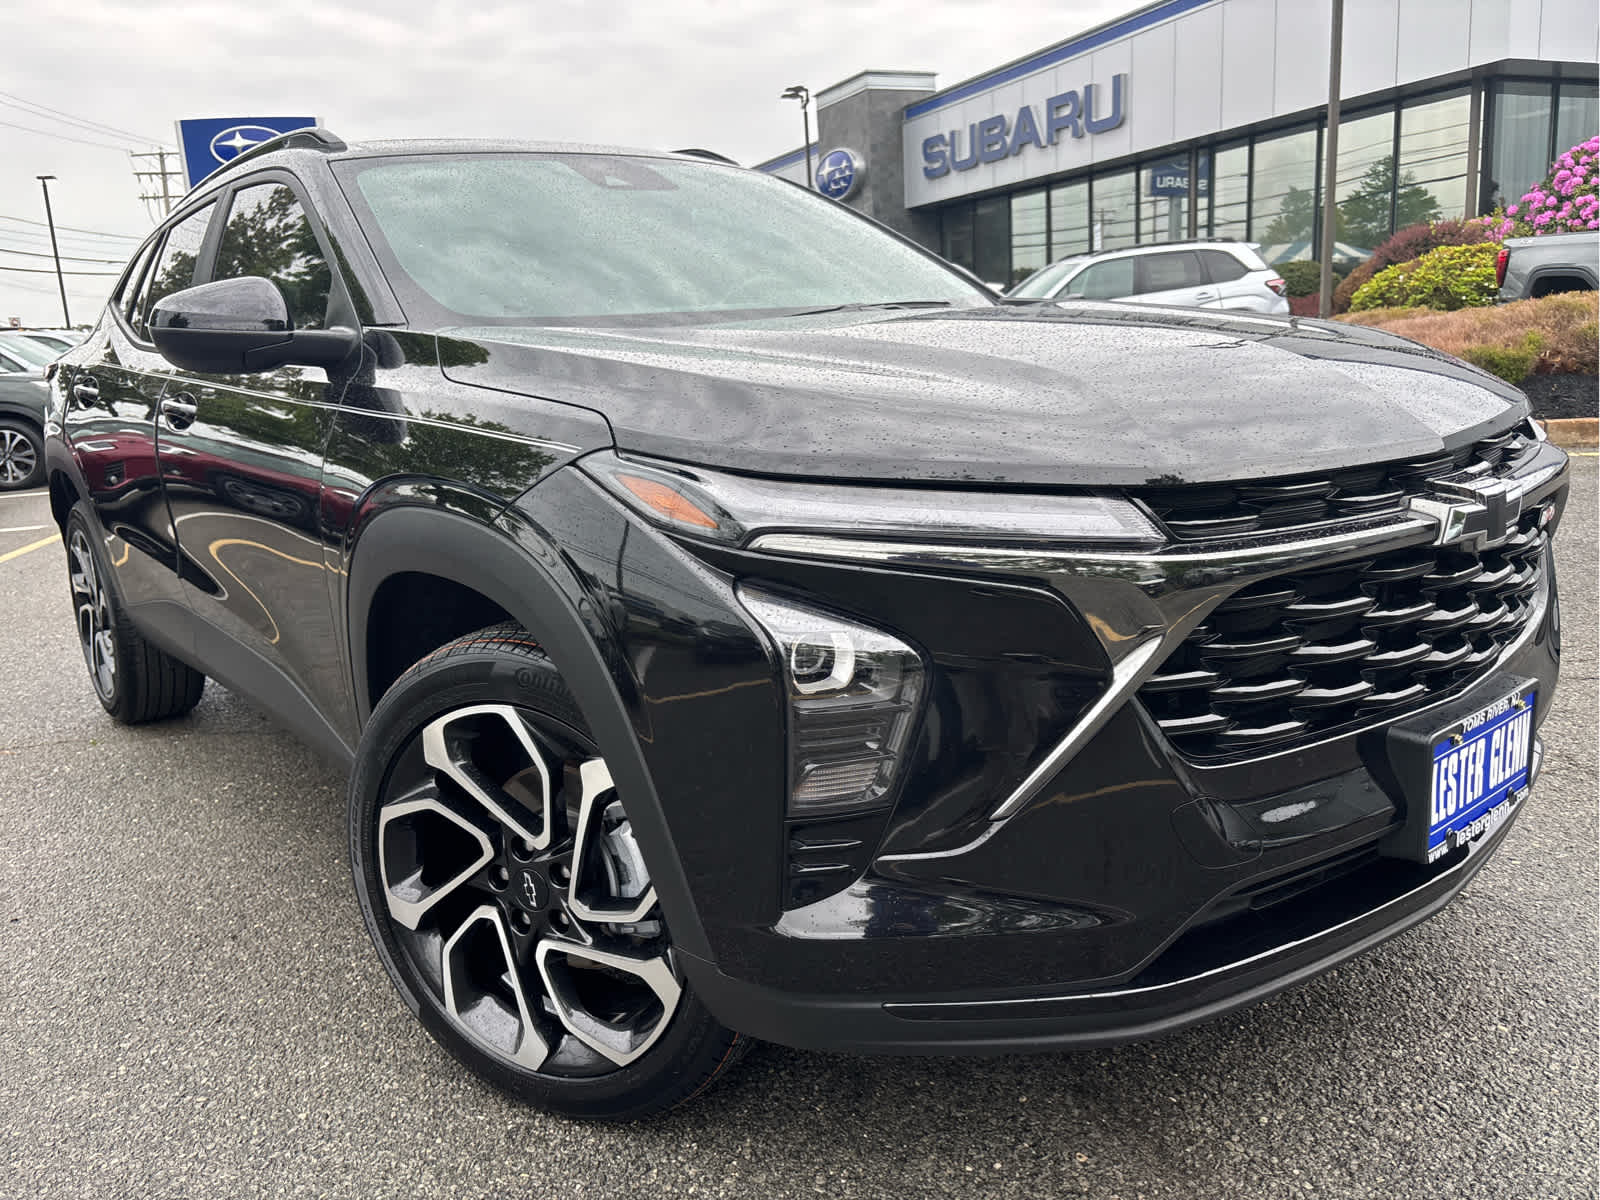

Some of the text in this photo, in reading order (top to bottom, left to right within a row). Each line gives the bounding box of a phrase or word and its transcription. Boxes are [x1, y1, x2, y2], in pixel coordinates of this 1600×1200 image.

[922, 74, 1126, 179] SUBARU
[1431, 710, 1531, 826] LESTER GLENN
[1462, 710, 1486, 733] TOMS
